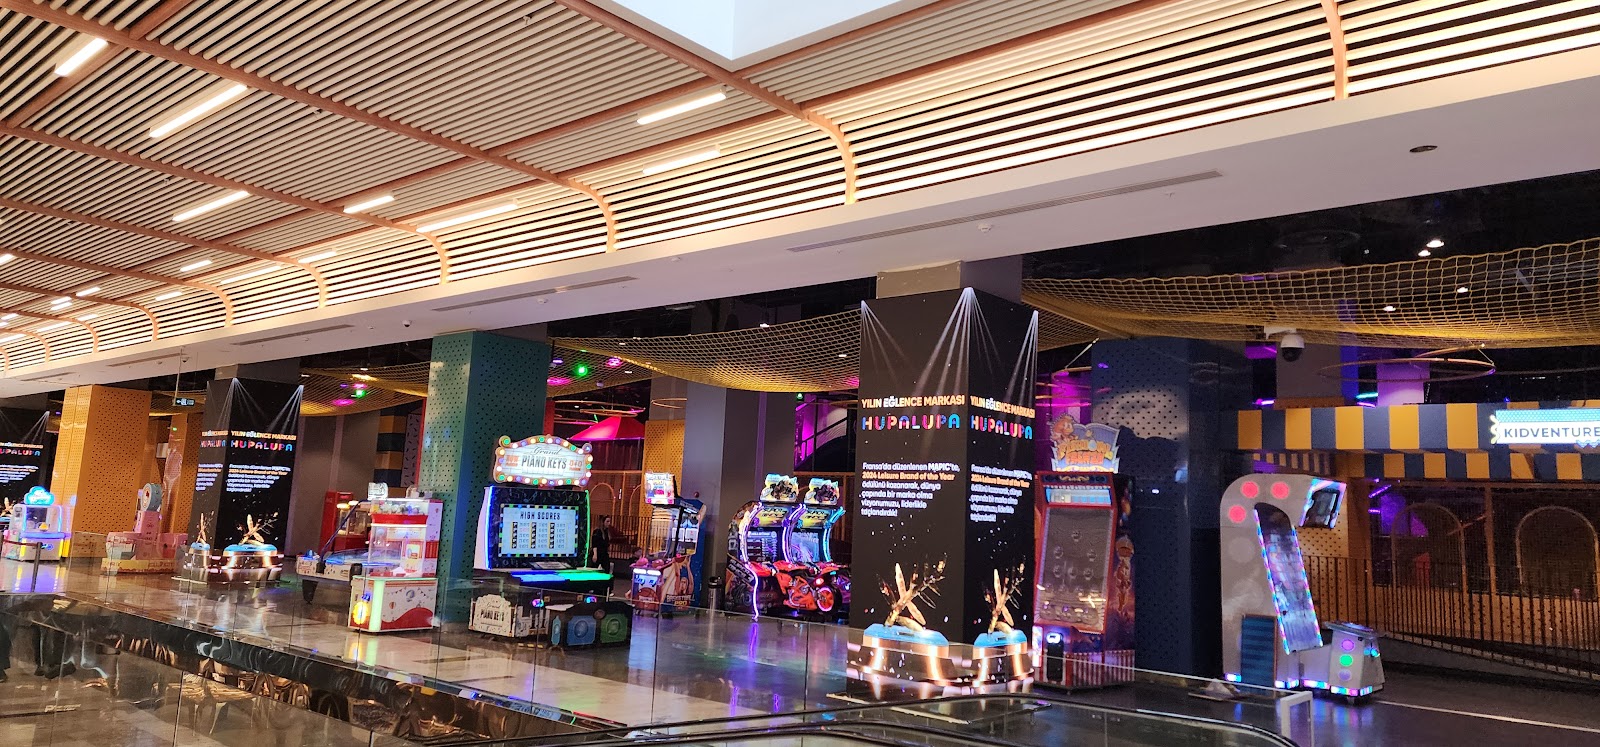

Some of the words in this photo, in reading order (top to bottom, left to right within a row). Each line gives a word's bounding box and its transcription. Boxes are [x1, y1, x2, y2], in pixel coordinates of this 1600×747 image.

[861, 398, 882, 409] YILIN
[883, 395, 922, 408] EĞLENCE
[924, 394, 965, 406] MARKASI
[970, 395, 985, 408] YILIN
[862, 413, 960, 431] HUPALUPA
[970, 415, 1033, 440] HUPALUPA
[1504, 427, 1600, 438] KIDVENTURE
[230, 440, 293, 452] HUPALUPA
[531, 446, 562, 456] Grand
[521, 455, 546, 468] PIANO
[547, 457, 567, 470] KEYS
[863, 462, 891, 470] Fransa'da
[892, 462, 928, 471] düzenlenen
[878, 471, 899, 480] Leisure
[900, 471, 919, 480] Brand
[920, 472, 927, 480] of
[927, 472, 939, 480] the
[939, 472, 955, 481] Year
[520, 511, 535, 519] HIGH
[537, 511, 561, 520] SCORES
